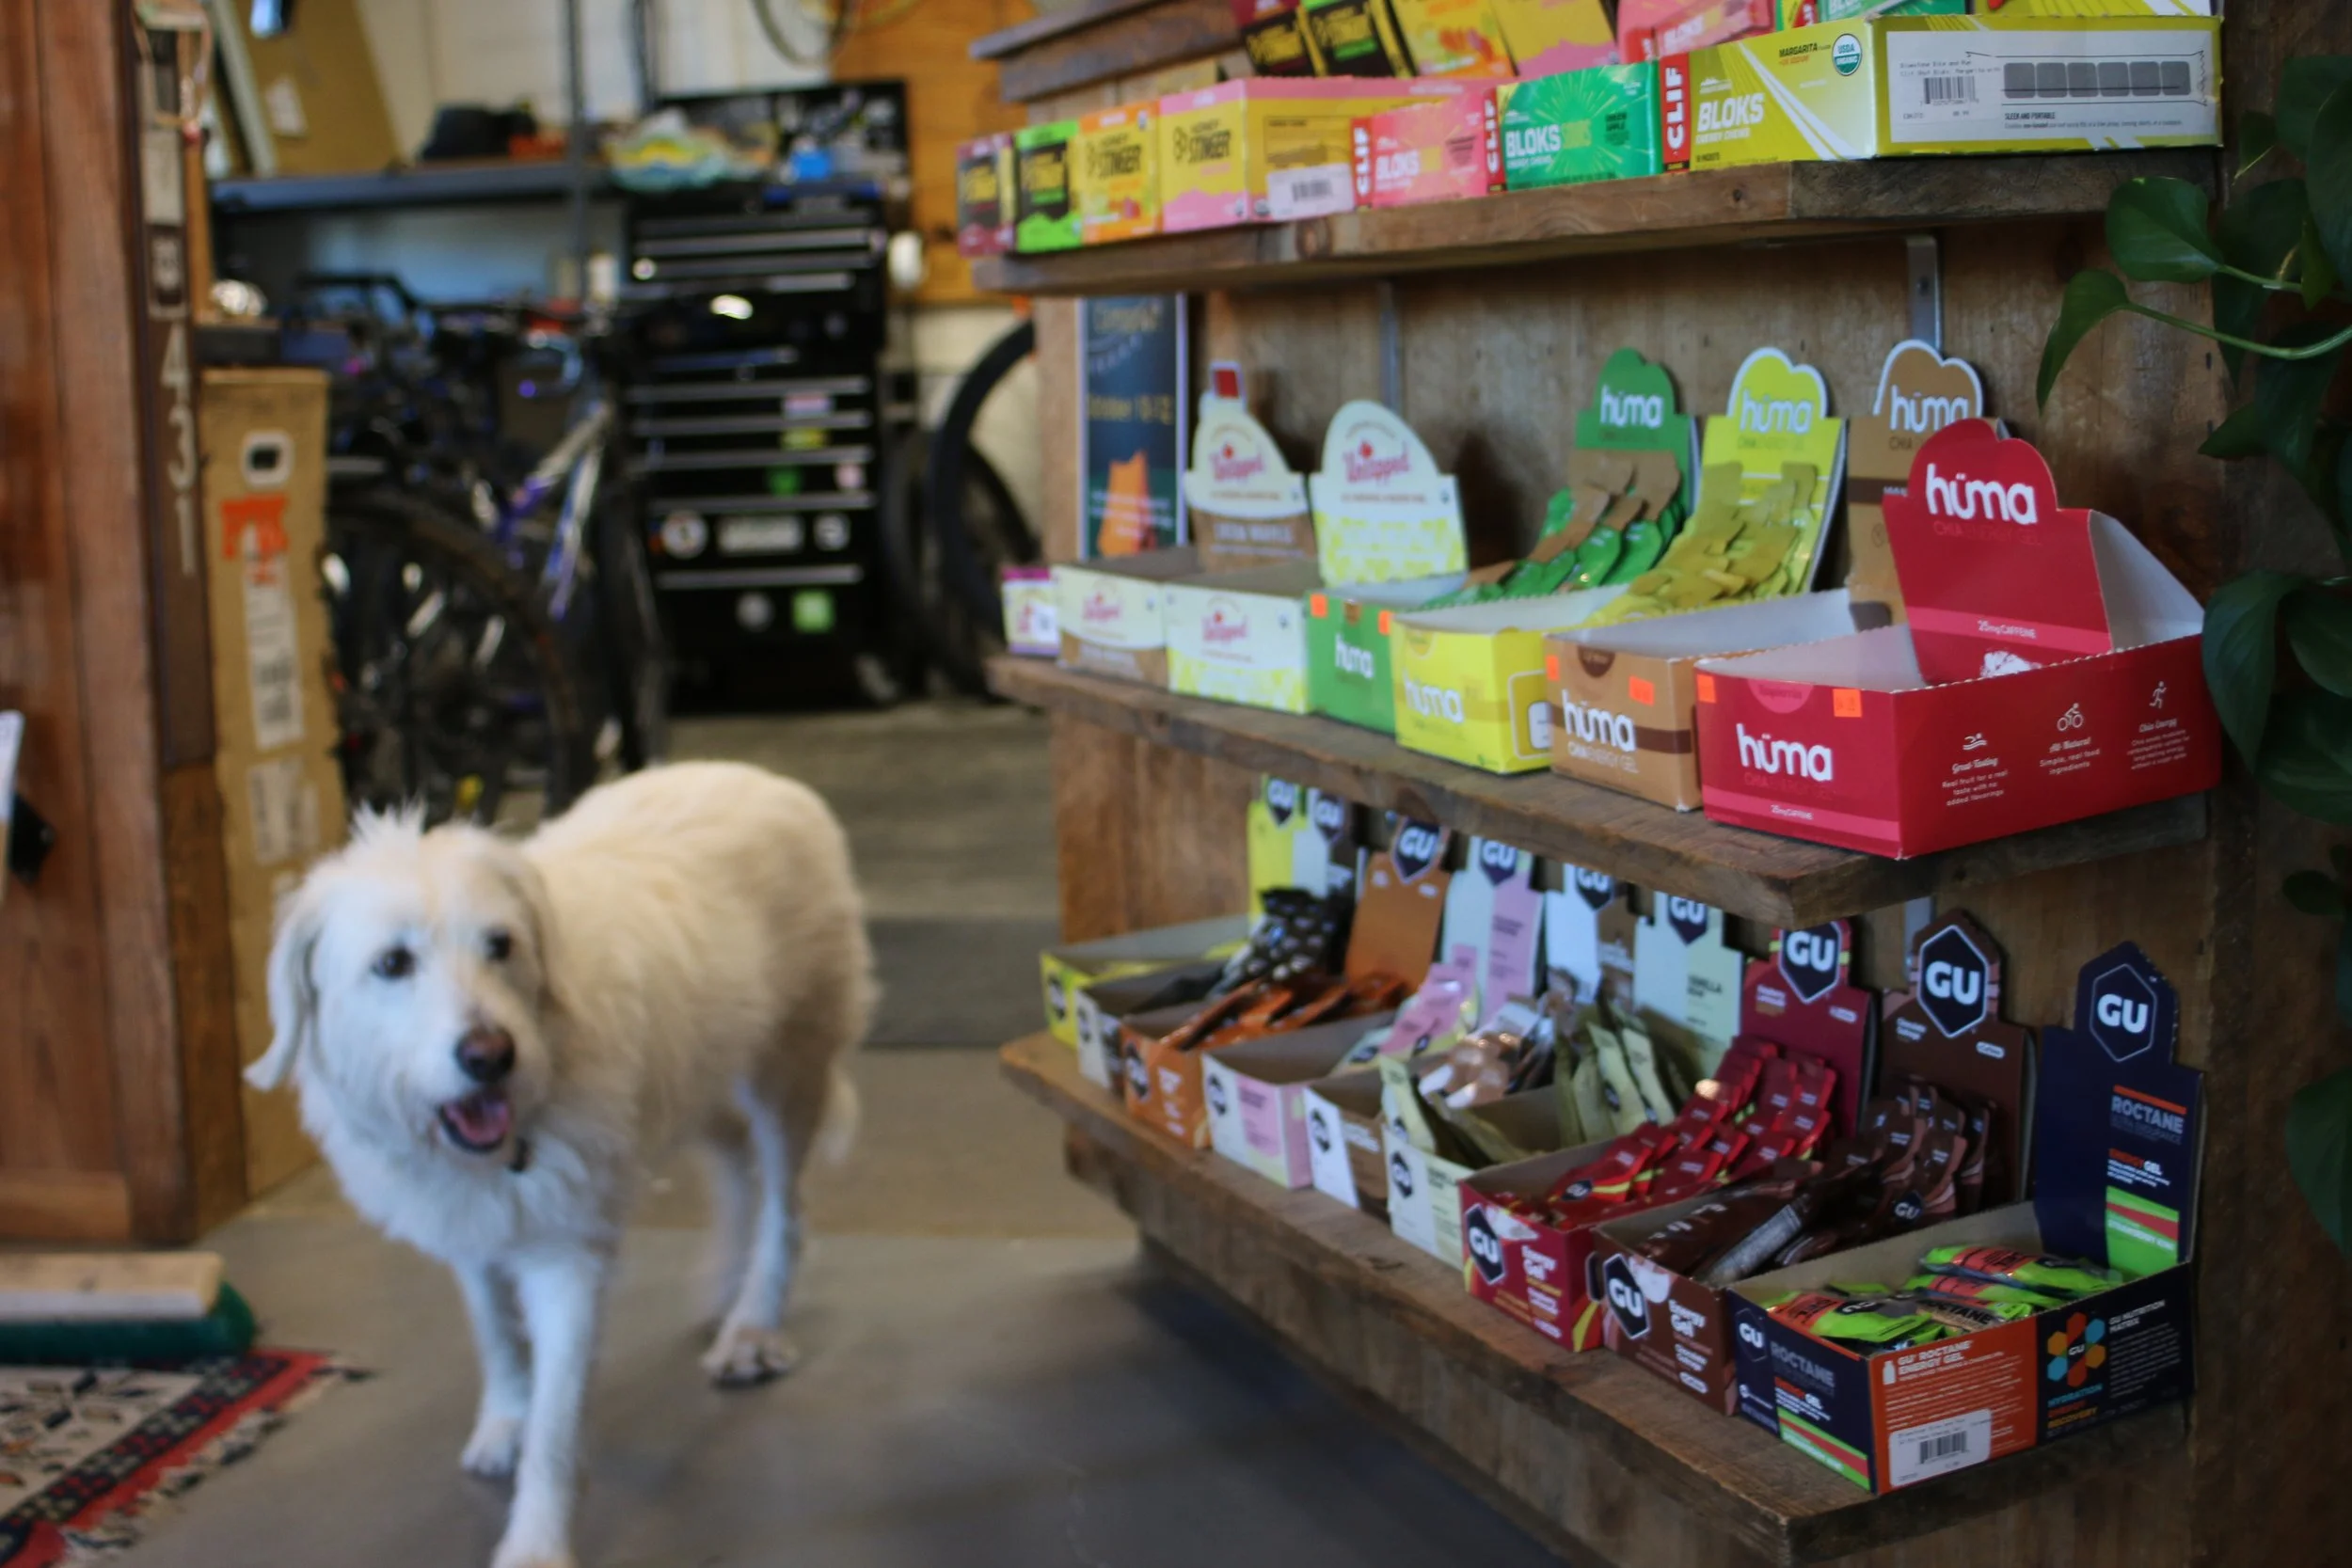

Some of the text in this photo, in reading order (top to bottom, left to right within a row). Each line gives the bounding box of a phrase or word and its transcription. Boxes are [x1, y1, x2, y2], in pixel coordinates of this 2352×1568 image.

[1778, 42, 1818, 57] MARGARITA
[1664, 68, 1685, 149] CLIF
[1696, 92, 1765, 133] BLOKS
[1485, 98, 1501, 174] CLIF
[1505, 123, 1562, 158] BLOKS
[1925, 462, 2039, 525] hüma
[1561, 689, 1638, 752] hüma
[1735, 722, 1833, 783] hüma
[1267, 778, 1295, 810] GU
[1946, 795, 1969, 807] added
[1398, 825, 1439, 861] GU
[1482, 839, 1516, 868] GU
[1787, 929, 1835, 973] GU
[1924, 959, 1981, 1006] GU
[2097, 992, 2148, 1034] GU
[2111, 1094, 2185, 1135] ROCTANE
[2143, 1159, 2164, 1177] GEL
[1468, 1226, 1500, 1264] GU
[1520, 1244, 1558, 1272] Energy
[1608, 1277, 1644, 1318] GU
[1667, 1298, 1707, 1329] Energy
[1670, 1314, 1696, 1338] Gel
[1739, 1322, 1765, 1349] GU
[1770, 1339, 1836, 1389] ROCTANE
[1898, 1352, 1965, 1376] ENERGY GEL
[2069, 1344, 2086, 1356] GU
[2047, 1383, 2105, 1408] HYDRATION
